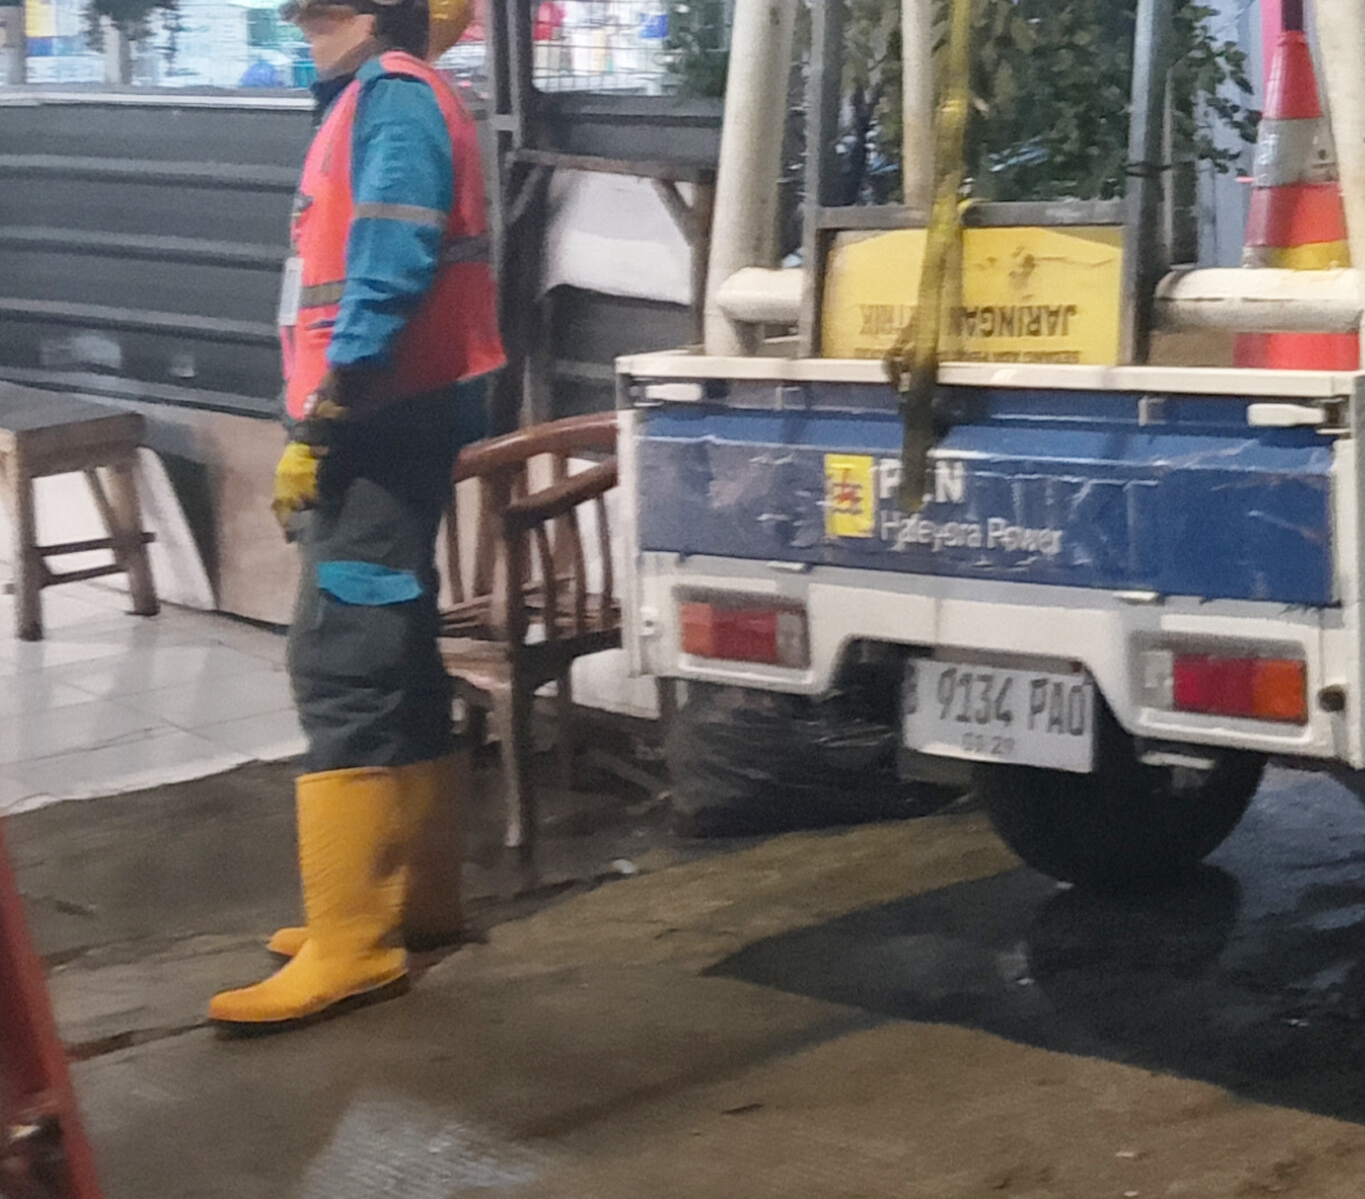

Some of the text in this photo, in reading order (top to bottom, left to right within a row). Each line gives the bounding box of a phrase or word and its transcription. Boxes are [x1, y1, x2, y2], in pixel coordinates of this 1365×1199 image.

[948, 305, 1077, 337] JARINGAN
[879, 458, 967, 503] PN
[987, 517, 1063, 555] Power
